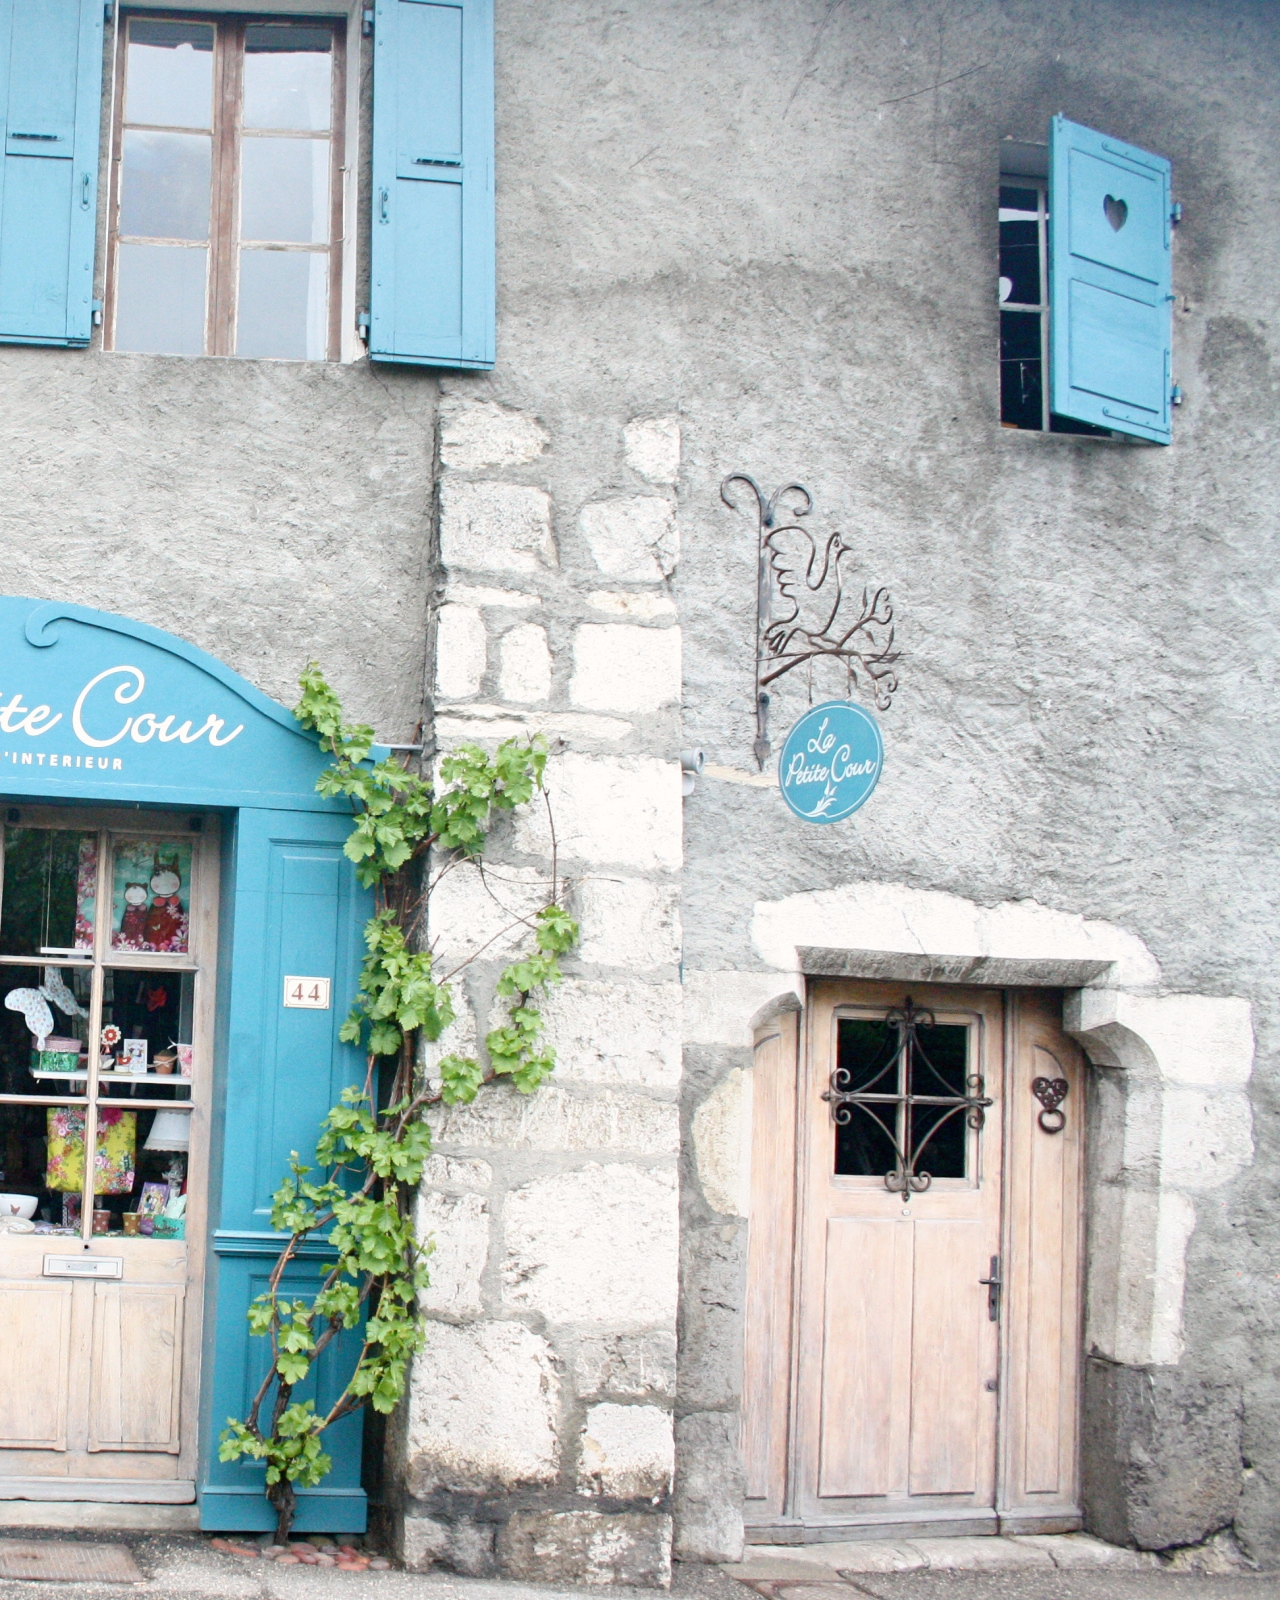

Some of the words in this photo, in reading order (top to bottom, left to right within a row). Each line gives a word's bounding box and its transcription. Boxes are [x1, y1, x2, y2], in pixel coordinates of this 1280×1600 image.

[72, 665, 245, 747] Cour
[807, 717, 836, 753] La
[785, 752, 830, 787] Petite
[830, 744, 876, 782] Cour
[291, 982, 320, 1001] 44
